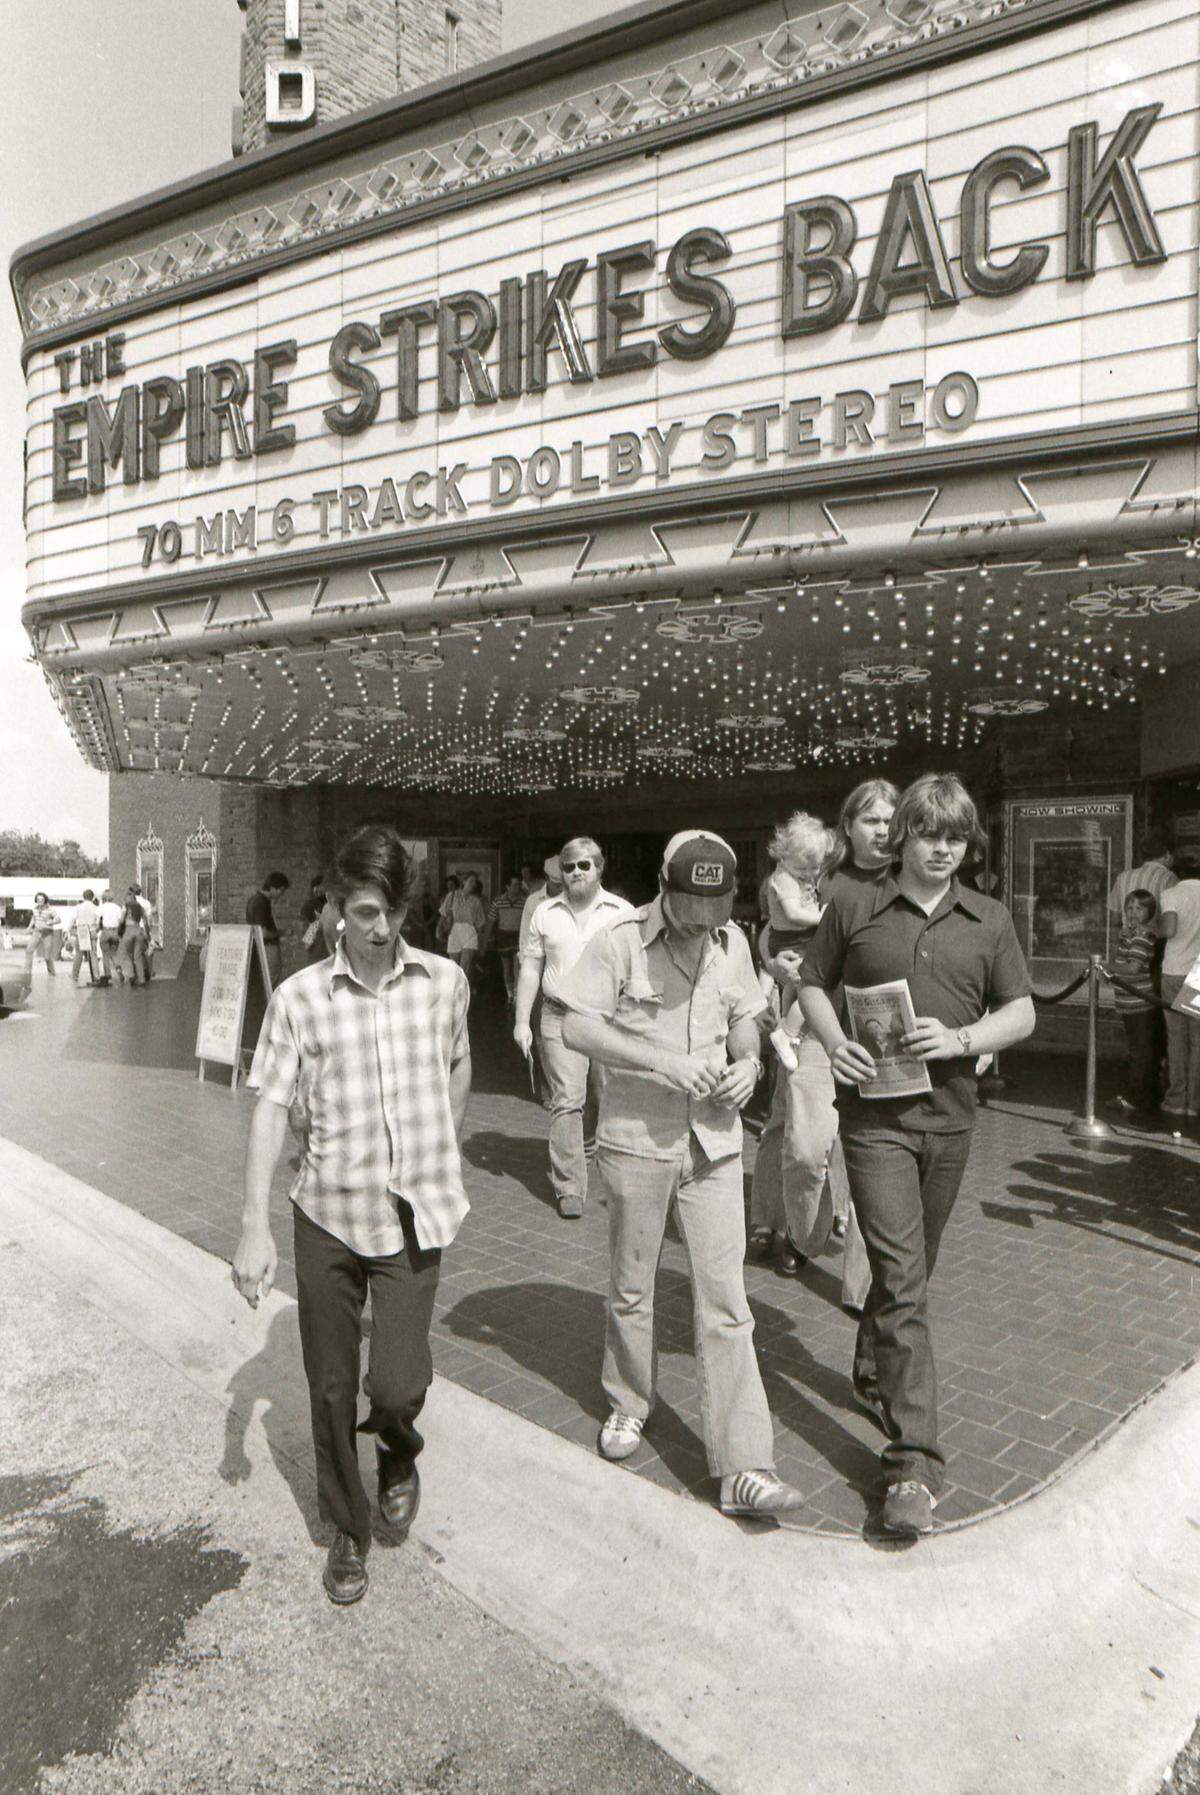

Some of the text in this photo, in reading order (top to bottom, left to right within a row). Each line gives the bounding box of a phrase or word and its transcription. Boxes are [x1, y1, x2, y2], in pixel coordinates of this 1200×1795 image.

[53, 102, 1168, 502] EMPIRE STRIKES BACK
[54, 333, 126, 392] THE
[138, 371, 980, 567] 70 MM 6 TRACK DOLBY STEREO
[1020, 807, 1050, 817] NOW
[695, 865, 721, 878] CAT
